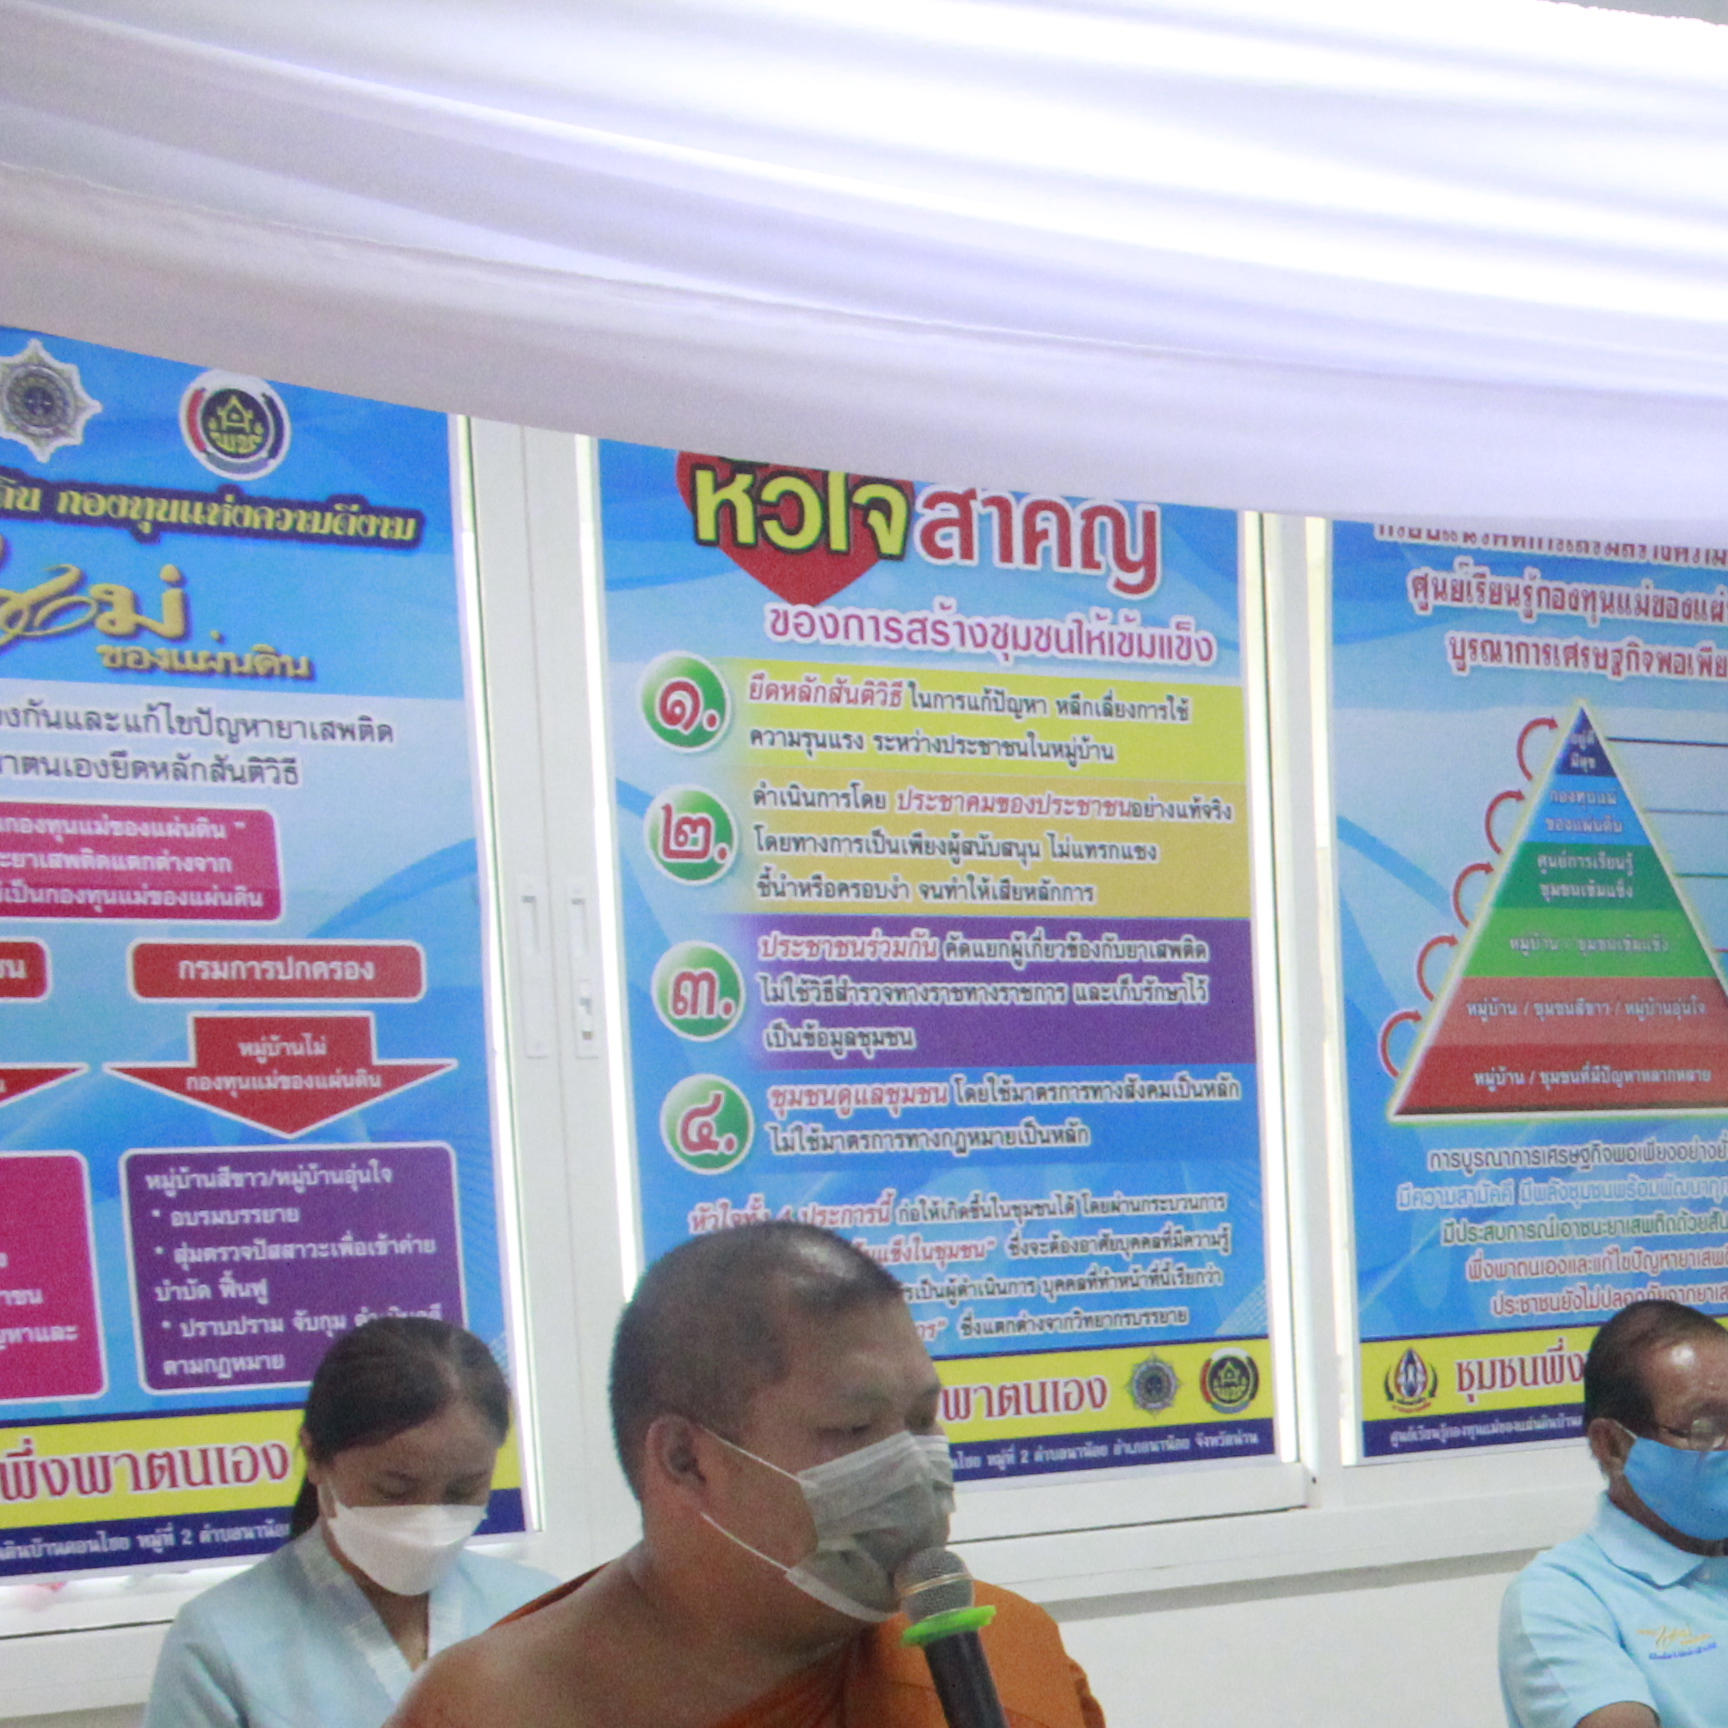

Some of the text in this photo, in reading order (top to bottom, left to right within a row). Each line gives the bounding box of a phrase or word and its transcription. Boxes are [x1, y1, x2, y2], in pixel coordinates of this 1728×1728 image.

[57, 489, 419, 540] กองทุนแห่งความดีงาม
[769, 602, 1214, 663] ของการสร้างชุมชนให้เข้มแข็ง
[96, 631, 312, 679] ของแผ่นดิน
[749, 673, 904, 706] ยึดหลักสันติวิธี
[910, 682, 1047, 720] ในการแก้ปัญหา
[1056, 692, 1190, 722] หลีกเลี่ยงการใช้
[750, 728, 1114, 767] ความรุนแรง ระหว่างประชาชนในหมู่บ้าน
[0, 750, 299, 787] าตนเองยึดหลักสันติวิธี
[754, 783, 886, 811] ดำเนินการโดย
[755, 828, 1041, 866] โดยทางการเป็นเพียงผู้สนับสนุน
[758, 868, 1095, 903] ชี้นำหรือครอบงำ จนทำให้เสียหลักการ
[759, 929, 939, 961] ประชาชนร่วมกัน
[944, 934, 1208, 968] คัดแยกผู้เกี่ยวข้องกับยาเสพติด
[178, 956, 375, 981] กรมการปกครอง
[1074, 974, 1208, 1002] และเก็บรักษาไว้
[765, 1021, 915, 1057] เป็นข้อมูลชุมชน
[186, 1070, 382, 1097] กองทุนแม่ของแผ่นดิน
[770, 1083, 949, 1118] ชุมชนดูแลชุมชน
[954, 1074, 1241, 1104] โดยใช้มาตรการทางสังคมเป็นหลัก
[170, 1207, 300, 1226] อบรมบรรยาย
[803, 1194, 891, 1228] ประการนี้
[900, 1196, 1076, 1225] ก่อให้เกิดขึ้นในชุมชนได้
[1083, 1193, 1227, 1216] โดยผ่านกระบวนการ
[154, 1270, 269, 1305] บำบัด ฟื้นฟู
[180, 1316, 284, 1337] ปราบปราม
[292, 1309, 346, 1338] จับกุม
[960, 1307, 1188, 1337] ซึ่งแตกต่างจากวิทยากรบรรยาย
[181, 1529, 193, 1545] 2
